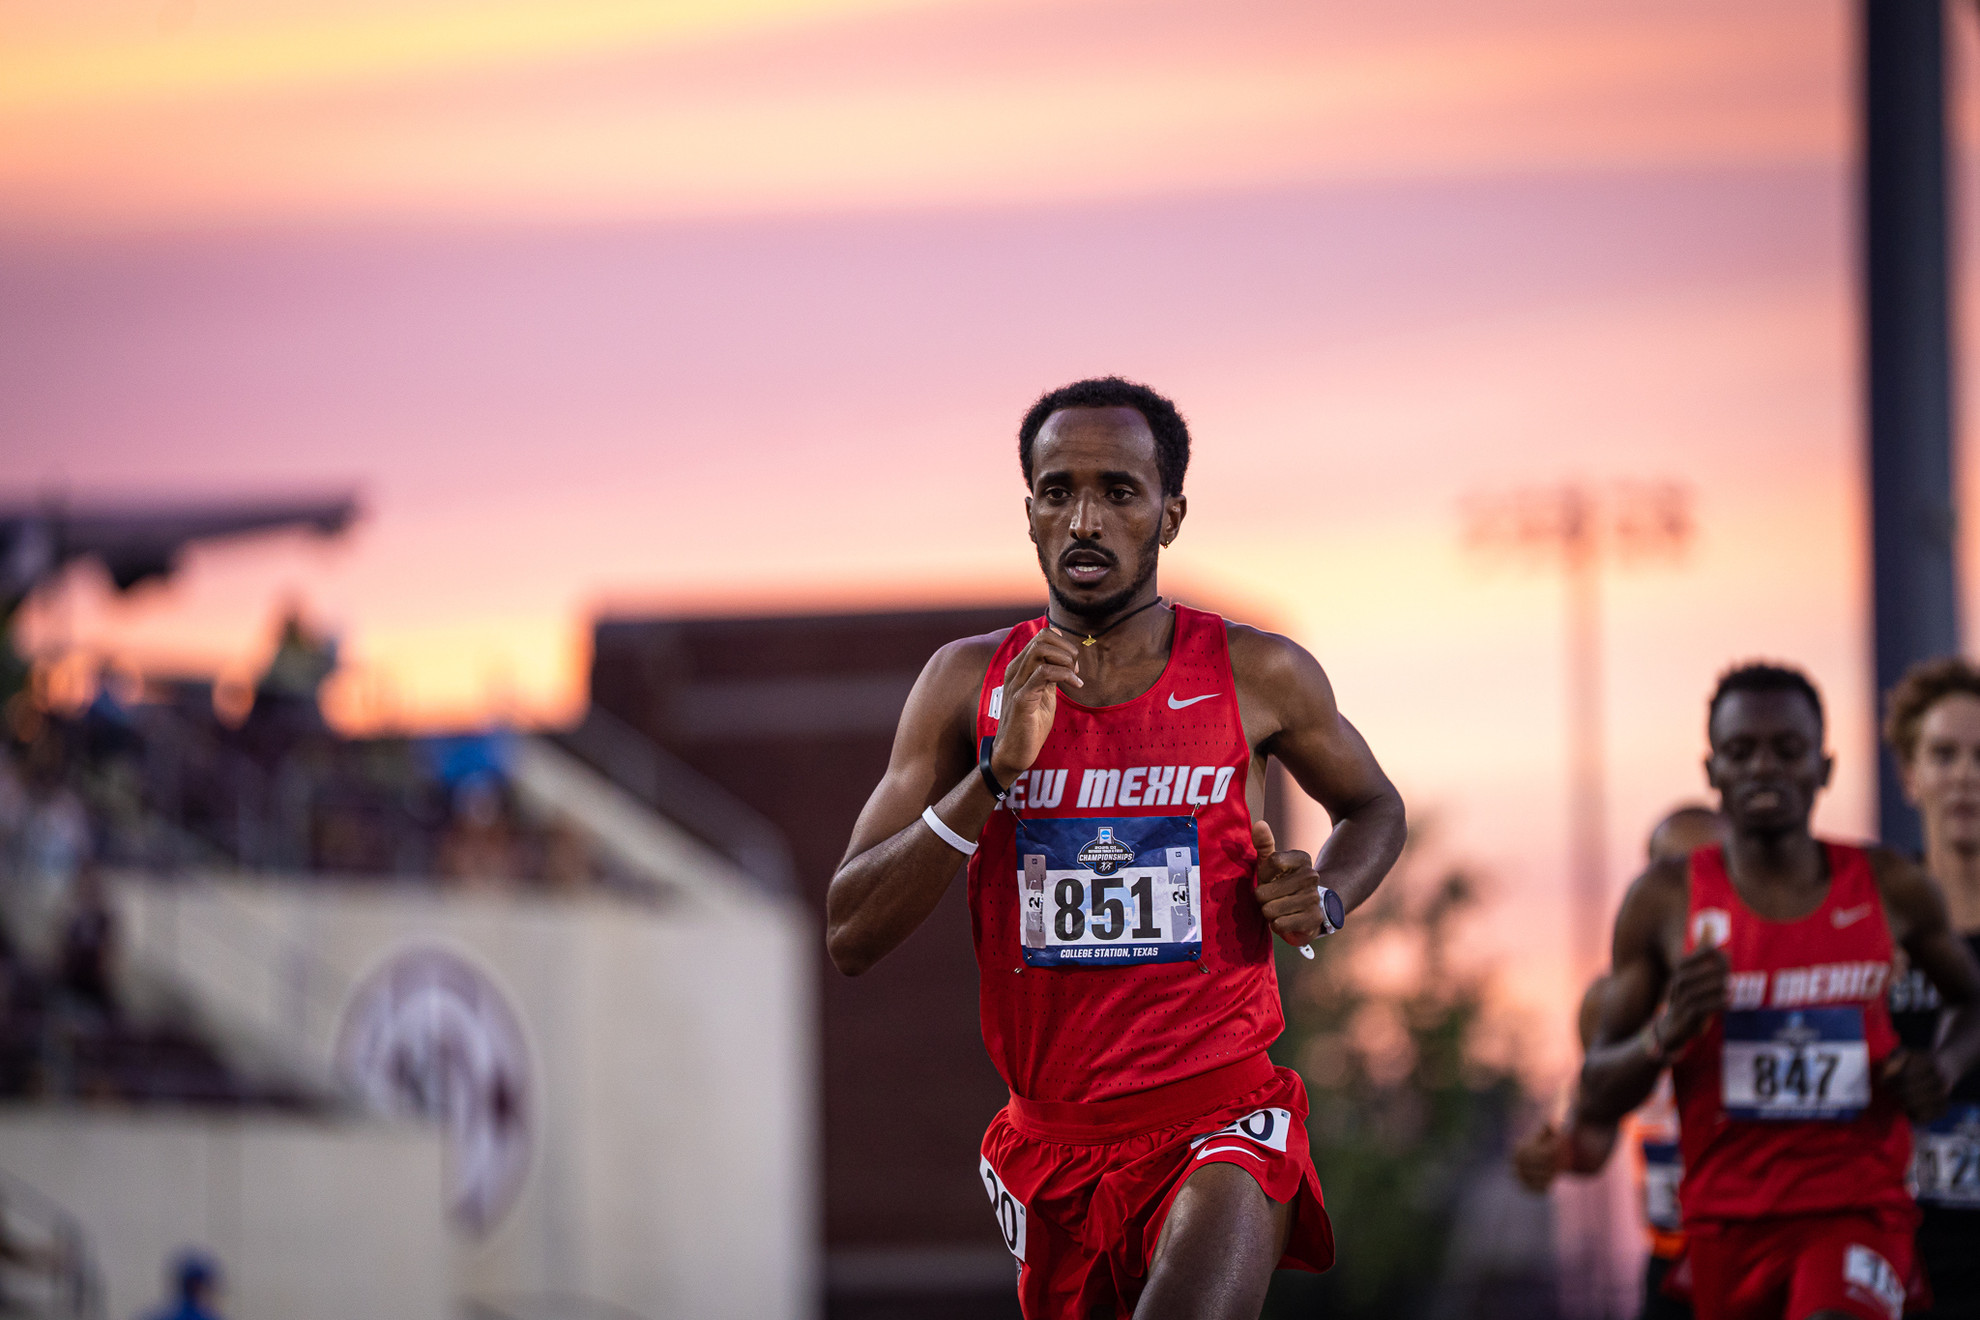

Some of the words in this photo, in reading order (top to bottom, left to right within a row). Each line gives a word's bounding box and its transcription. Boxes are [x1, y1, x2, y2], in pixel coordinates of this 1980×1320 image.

[994, 769, 1068, 811] EW
[1076, 766, 1236, 809] MEXICO
[1028, 897, 1040, 908] 2
[1054, 876, 1162, 941] 851
[1172, 890, 1185, 902] 2
[1060, 948, 1093, 958] COLLEGE
[1094, 948, 1130, 958] STATION,
[1132, 947, 1159, 957] TEXAS
[1753, 1053, 1841, 1099] 847
